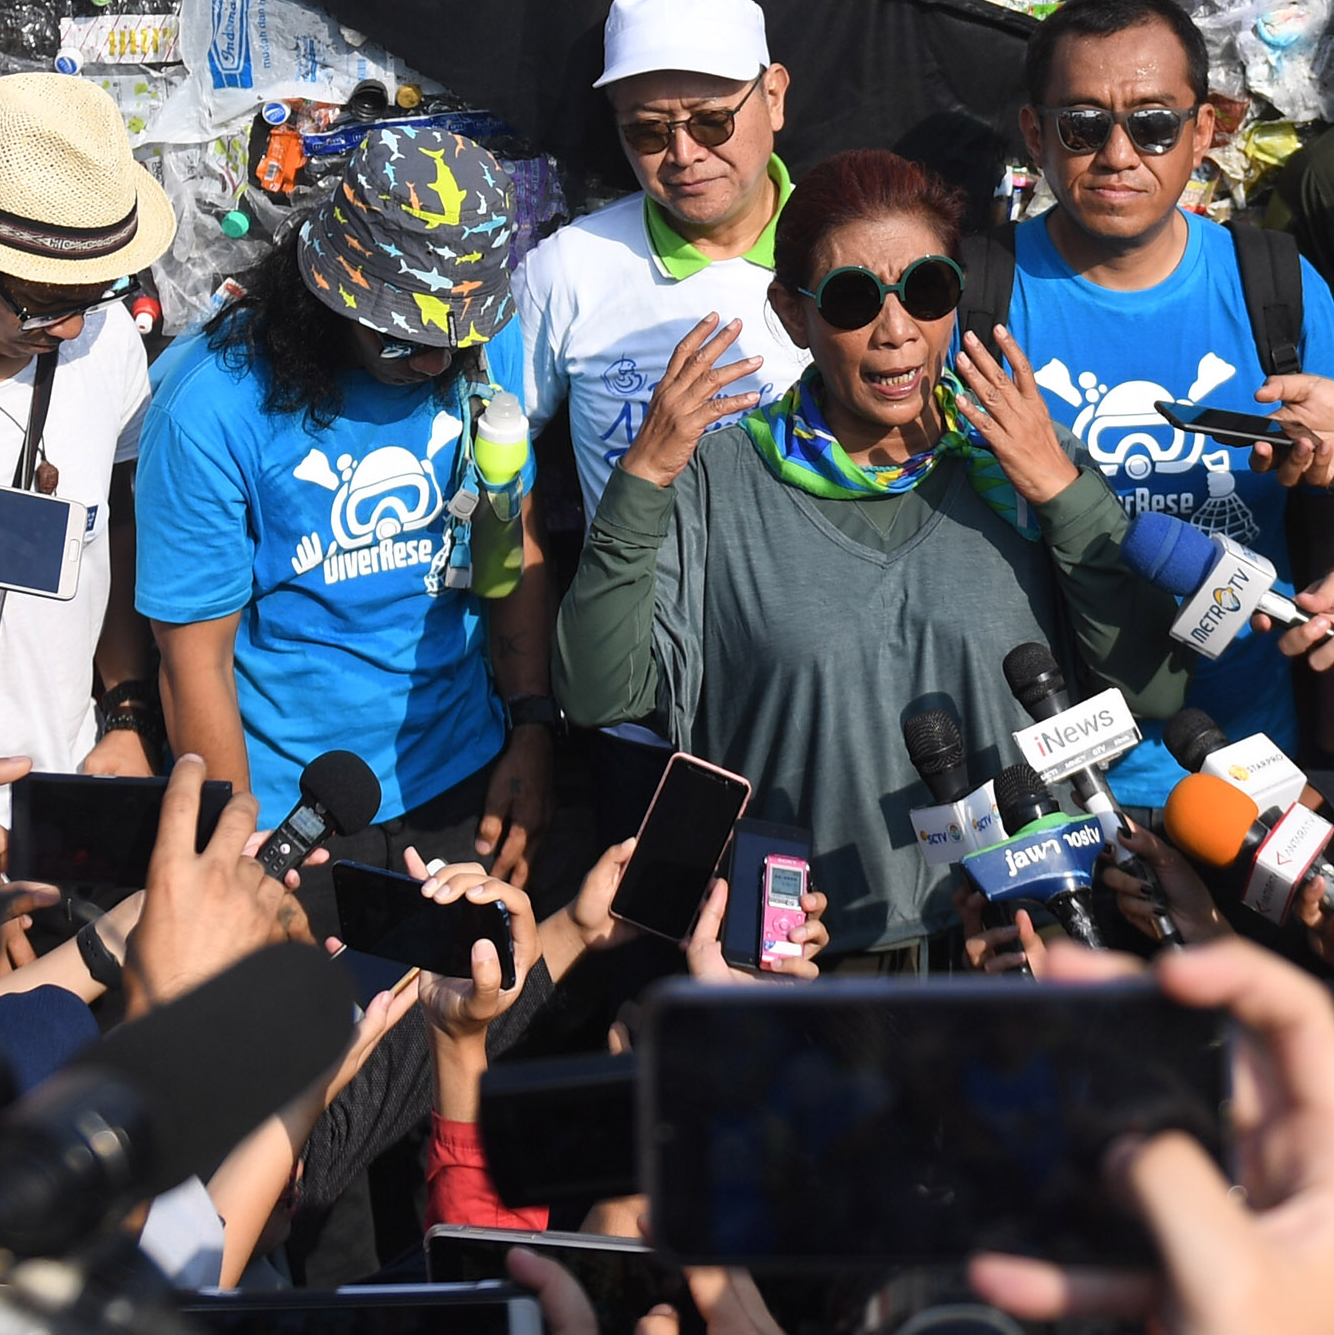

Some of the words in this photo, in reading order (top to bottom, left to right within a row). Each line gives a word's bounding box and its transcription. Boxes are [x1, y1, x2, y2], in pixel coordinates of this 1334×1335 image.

[1033, 707, 1116, 758] iNews
[975, 815, 993, 832] SCTV
[927, 830, 948, 845] SCTV
